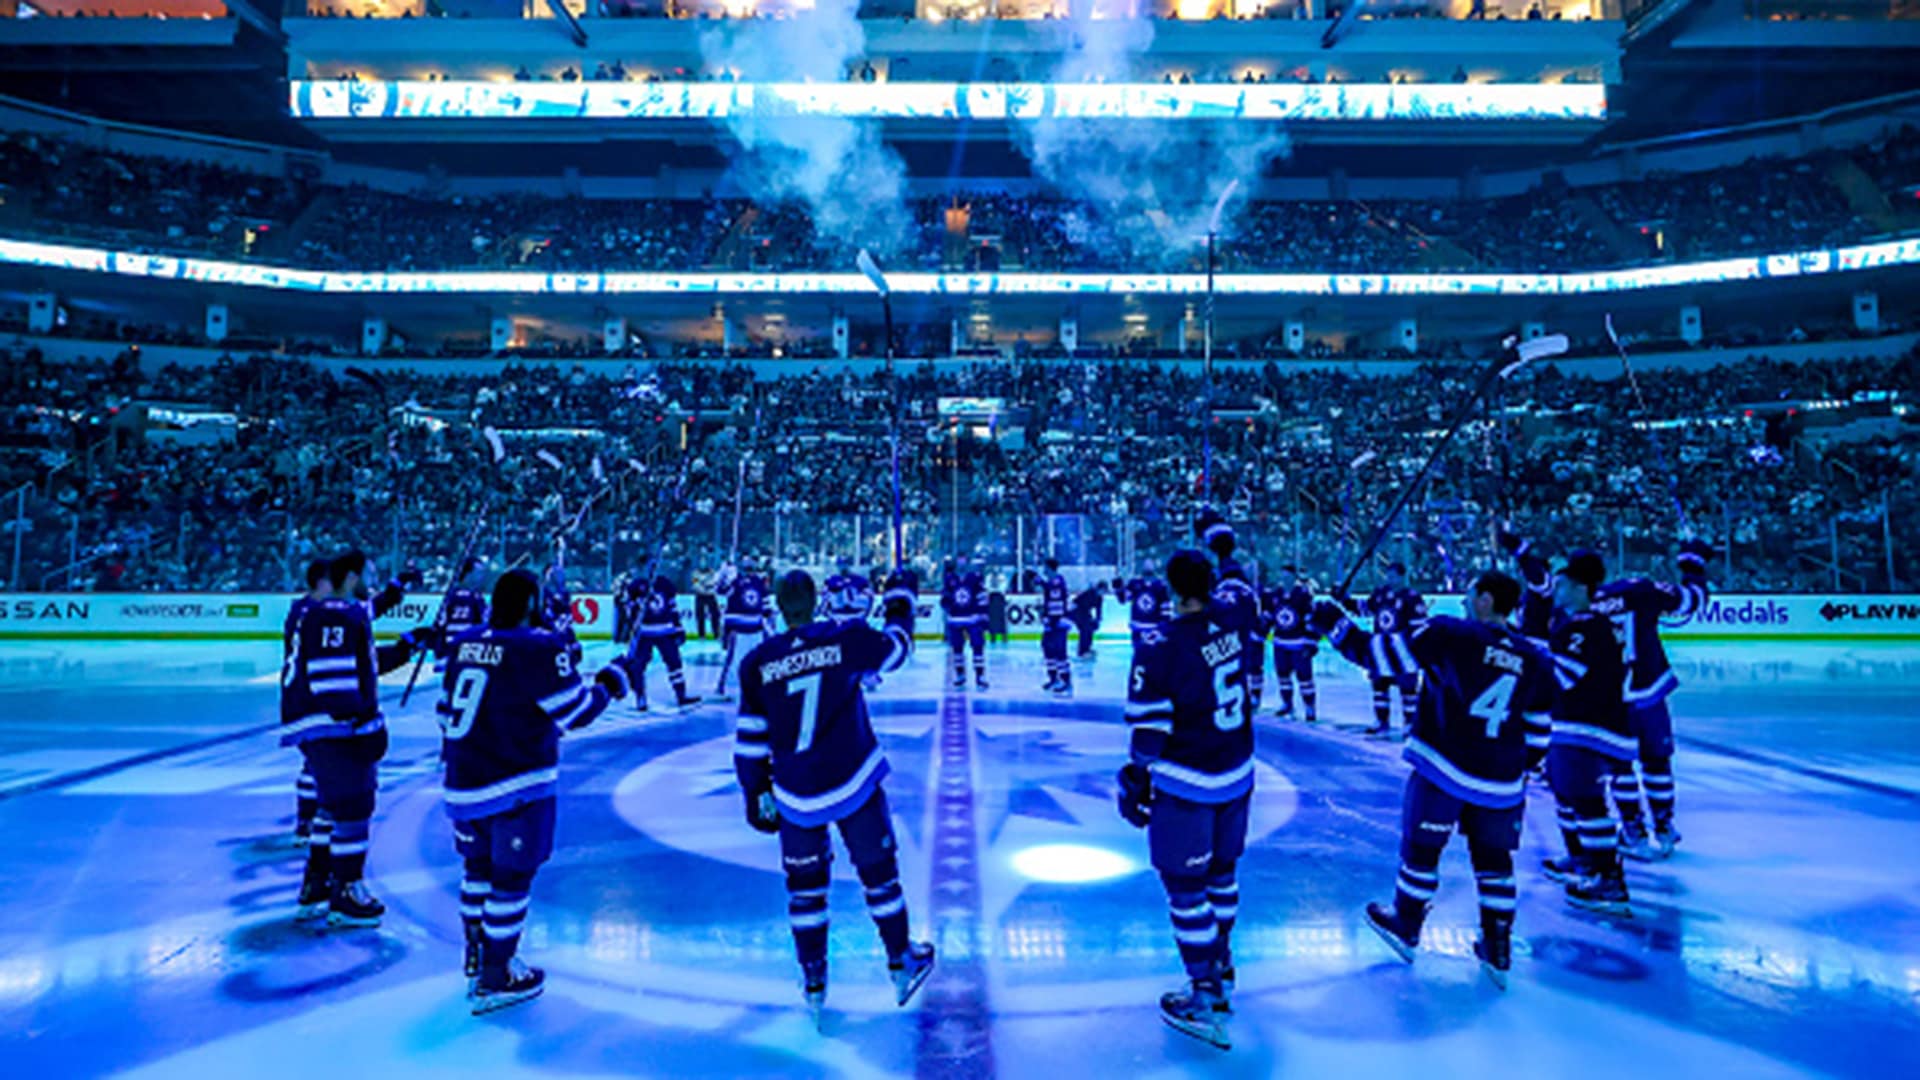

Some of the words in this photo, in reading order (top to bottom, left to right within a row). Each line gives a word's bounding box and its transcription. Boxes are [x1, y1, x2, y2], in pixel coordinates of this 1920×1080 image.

[1697, 600, 1789, 624] Medals
[1836, 604, 1920, 619] PLAYN
[322, 626, 345, 648] 13
[1568, 633, 1585, 653] 2
[555, 653, 571, 677] 9
[446, 668, 489, 739] 9
[1213, 659, 1245, 732] 5
[1469, 674, 1517, 738] 4
[786, 672, 822, 754] 7
